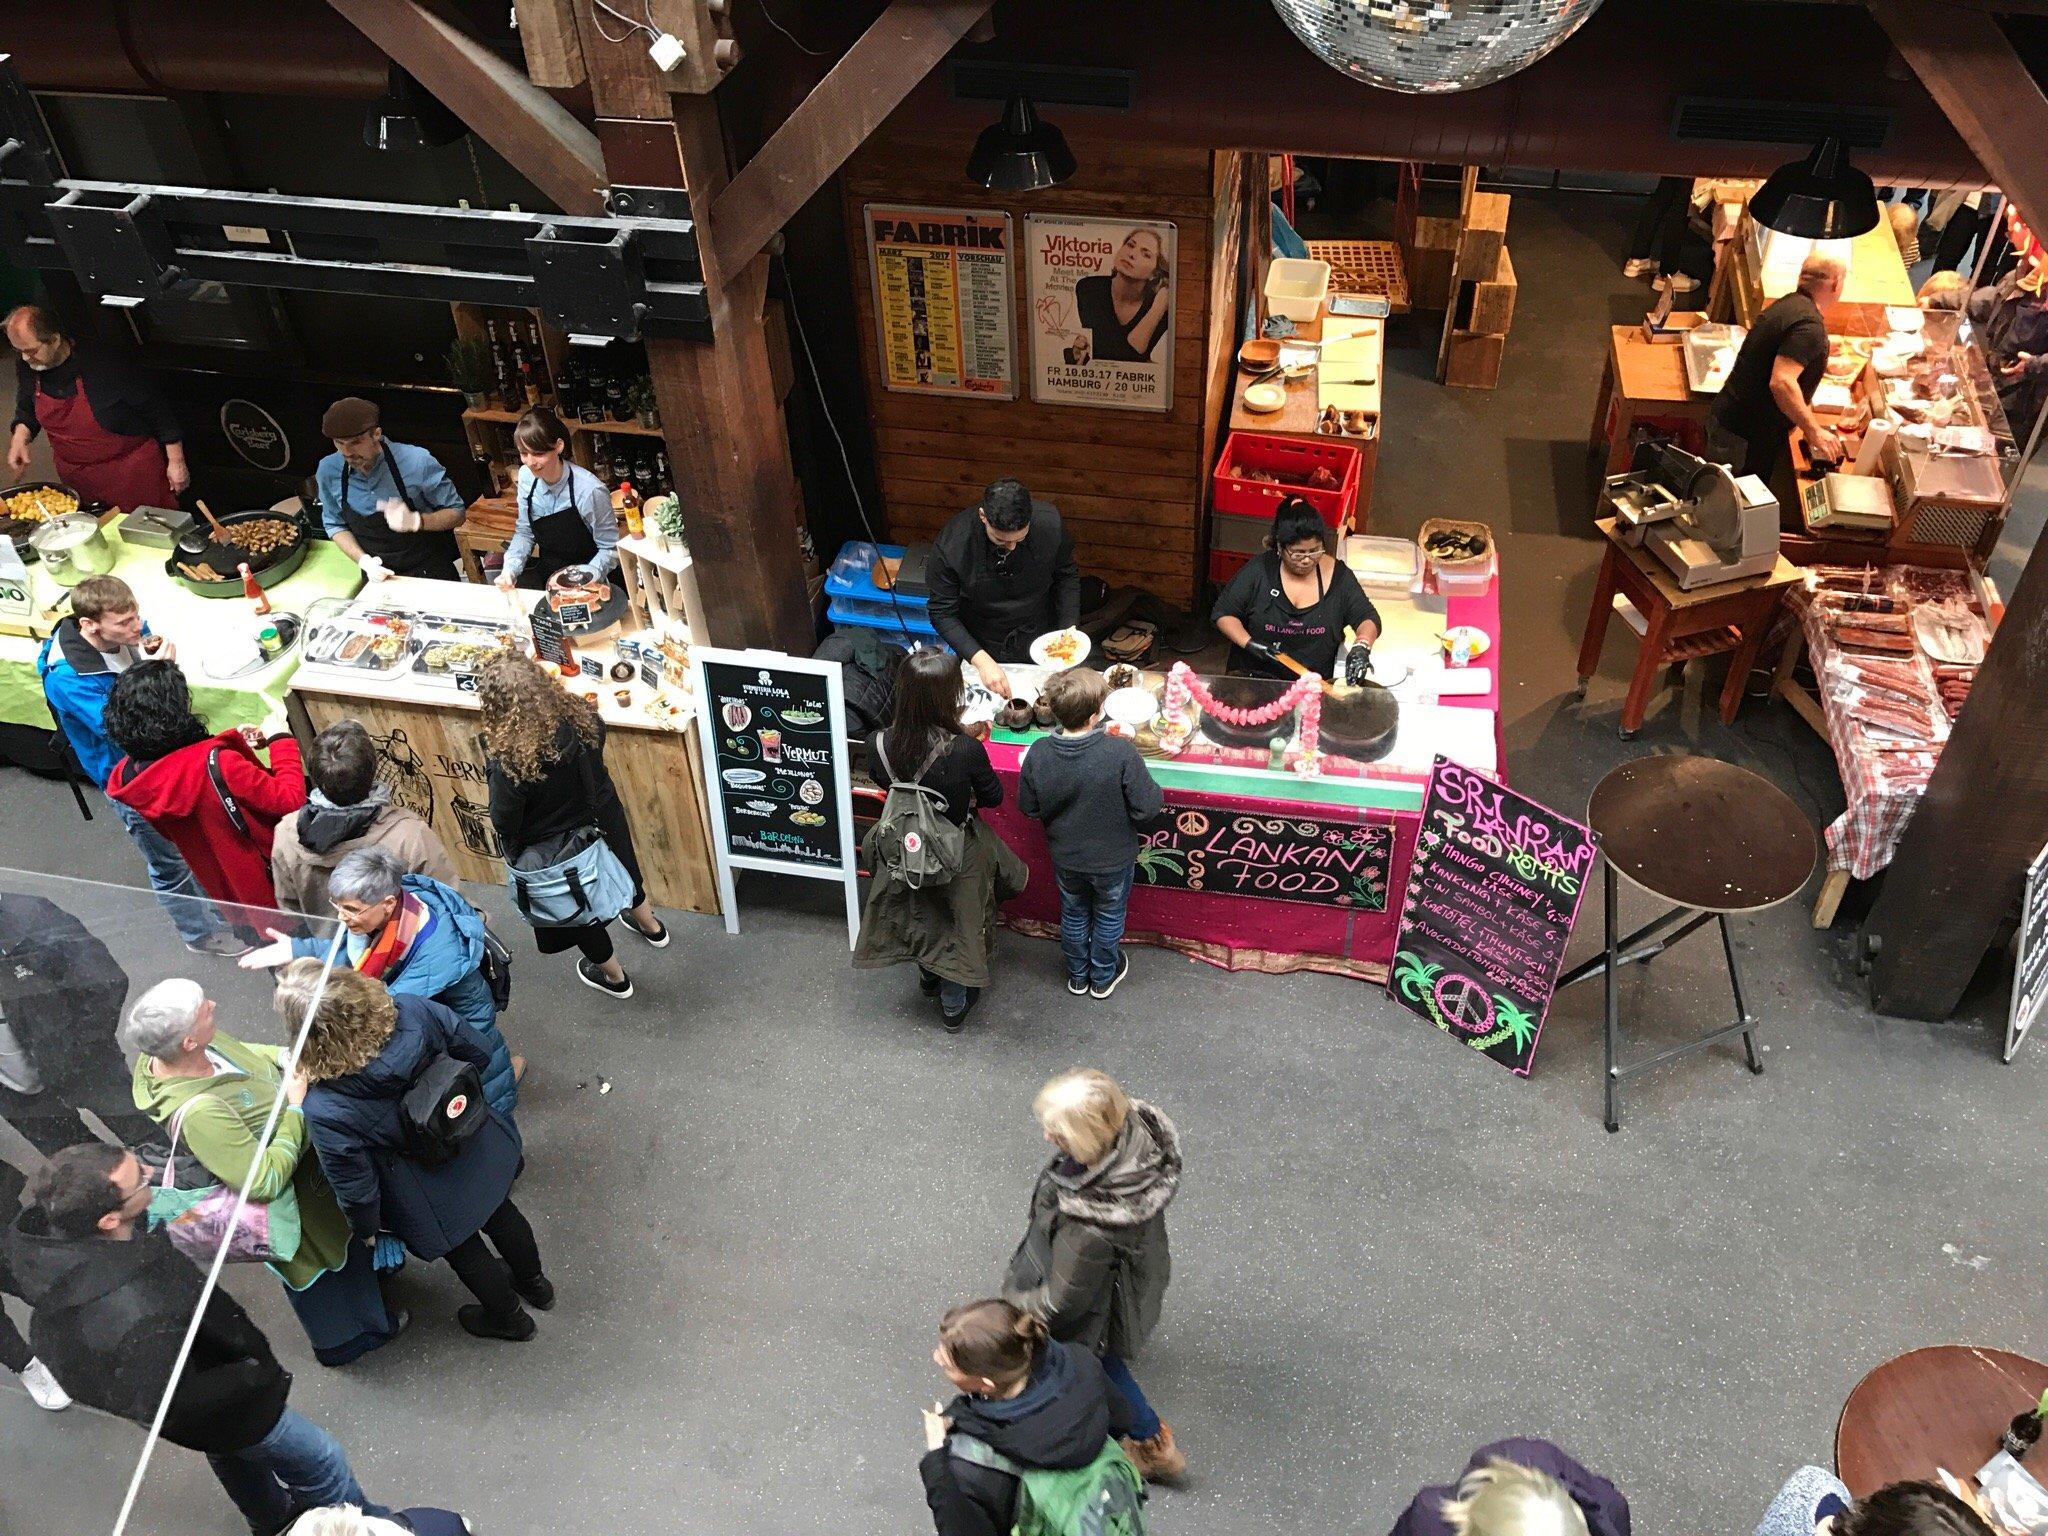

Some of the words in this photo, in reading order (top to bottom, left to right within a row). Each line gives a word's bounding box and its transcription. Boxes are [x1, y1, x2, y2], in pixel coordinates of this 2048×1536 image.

[874, 216, 1006, 249] FABRIK
[1046, 234, 1113, 255] Viktoria
[928, 250, 951, 260] 2017
[958, 252, 1001, 262] VORSCHAU
[1040, 249, 1103, 272] Tolstoy
[1050, 275, 1059, 283] At
[1062, 276, 1076, 284] The
[1047, 366, 1061, 376] FR
[1065, 367, 1112, 379] 10.03.17
[1116, 371, 1156, 382] FABRIK
[1047, 377, 1101, 389] HAMBURG
[1115, 382, 1128, 392] 20
[1132, 384, 1156, 393] UHR
[229, 423, 278, 442] Carlsberg
[1264, 624, 1276, 632] SRI
[1306, 626, 1326, 635] FOOD
[772, 687, 790, 696] LOLA
[1435, 766, 1505, 824] SRI
[1433, 809, 1503, 858] FOOD
[1472, 805, 1591, 874] LANKAN
[1206, 827, 1366, 873] LANKAN
[1440, 842, 1486, 873] MANGO
[1217, 858, 1340, 893] FOOD
[1429, 861, 1491, 902] KANKUNG
[1505, 904, 1543, 930] KÄSE
[1423, 877, 1450, 895] CINI
[1452, 892, 1499, 925] SAMBOL
[1509, 924, 1543, 950] KÄSE
[1546, 909, 1571, 925] 4,50
[1415, 921, 1467, 953] AVOCADO
[1475, 940, 1514, 966] KÄSE
[1523, 969, 1549, 990] 6,50
